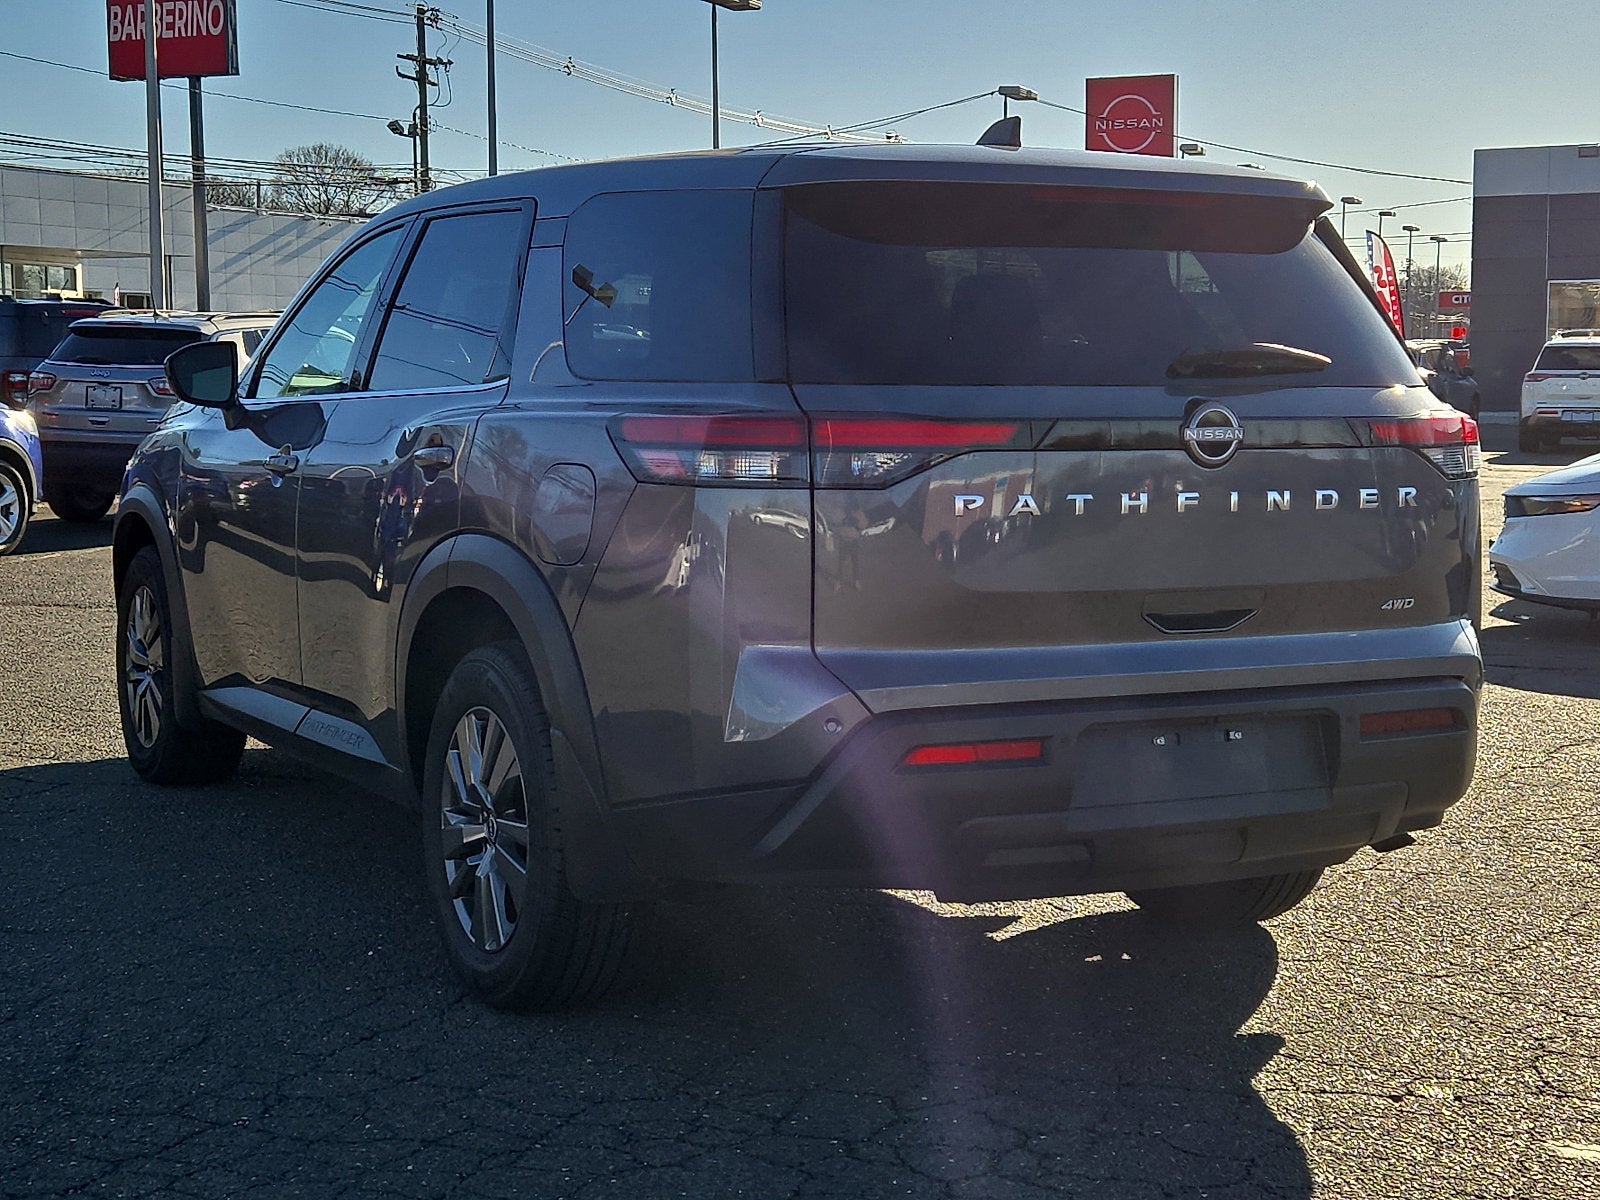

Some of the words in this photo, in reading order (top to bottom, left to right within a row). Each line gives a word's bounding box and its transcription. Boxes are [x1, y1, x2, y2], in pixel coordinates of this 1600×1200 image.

[1095, 117, 1163, 130] NISSAN
[1452, 294, 1472, 304] CIT
[1186, 429, 1244, 439] NISSAN
[953, 486, 1418, 516] PATHFINDER
[1381, 598, 1415, 610] 4WD
